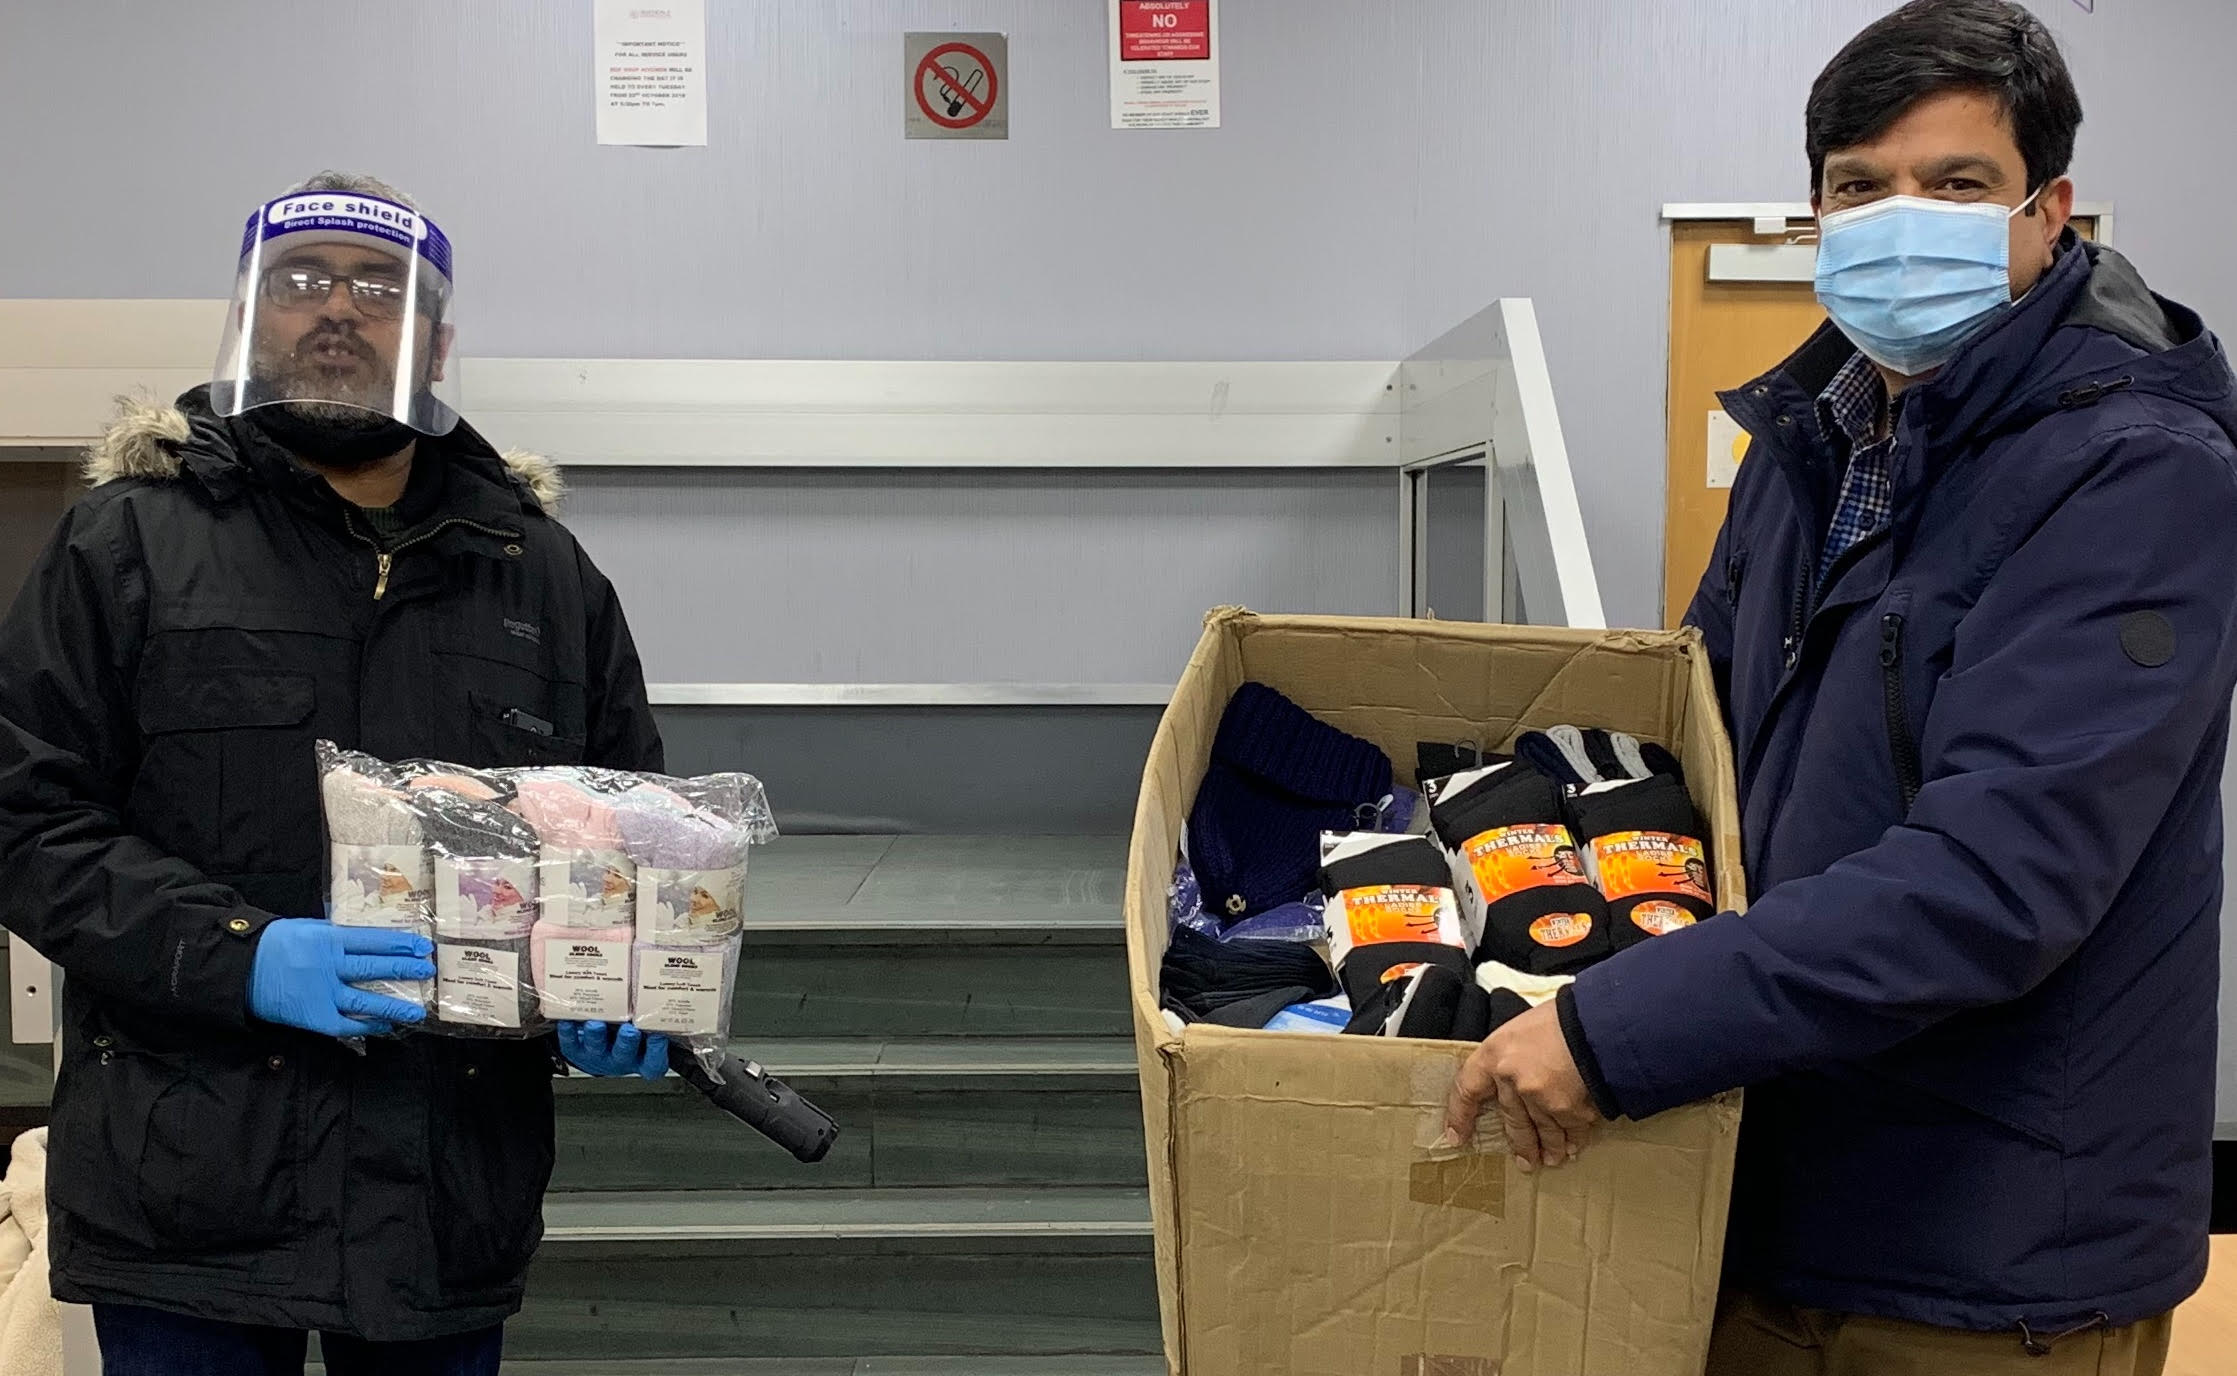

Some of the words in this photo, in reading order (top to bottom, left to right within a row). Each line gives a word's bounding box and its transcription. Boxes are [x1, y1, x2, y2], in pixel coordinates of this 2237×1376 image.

[1139, 2, 1190, 10] ABSOLUTELY
[1152, 13, 1177, 28] NO
[283, 201, 334, 216] Face
[345, 201, 413, 229] shield
[284, 217, 314, 229] Direct
[317, 216, 354, 227] Splash
[356, 221, 410, 244] protection
[1427, 779, 1437, 793] 3
[1567, 783, 1577, 794] 3
[1499, 828, 1535, 837] WINTER
[1473, 834, 1565, 857] THERMALS
[1602, 840, 1698, 856] THERMALS
[1352, 894, 1442, 906] THERMAL
[464, 950, 491, 960] WOOL
[572, 945, 600, 953] WOOL
[667, 957, 695, 965] WOOL
